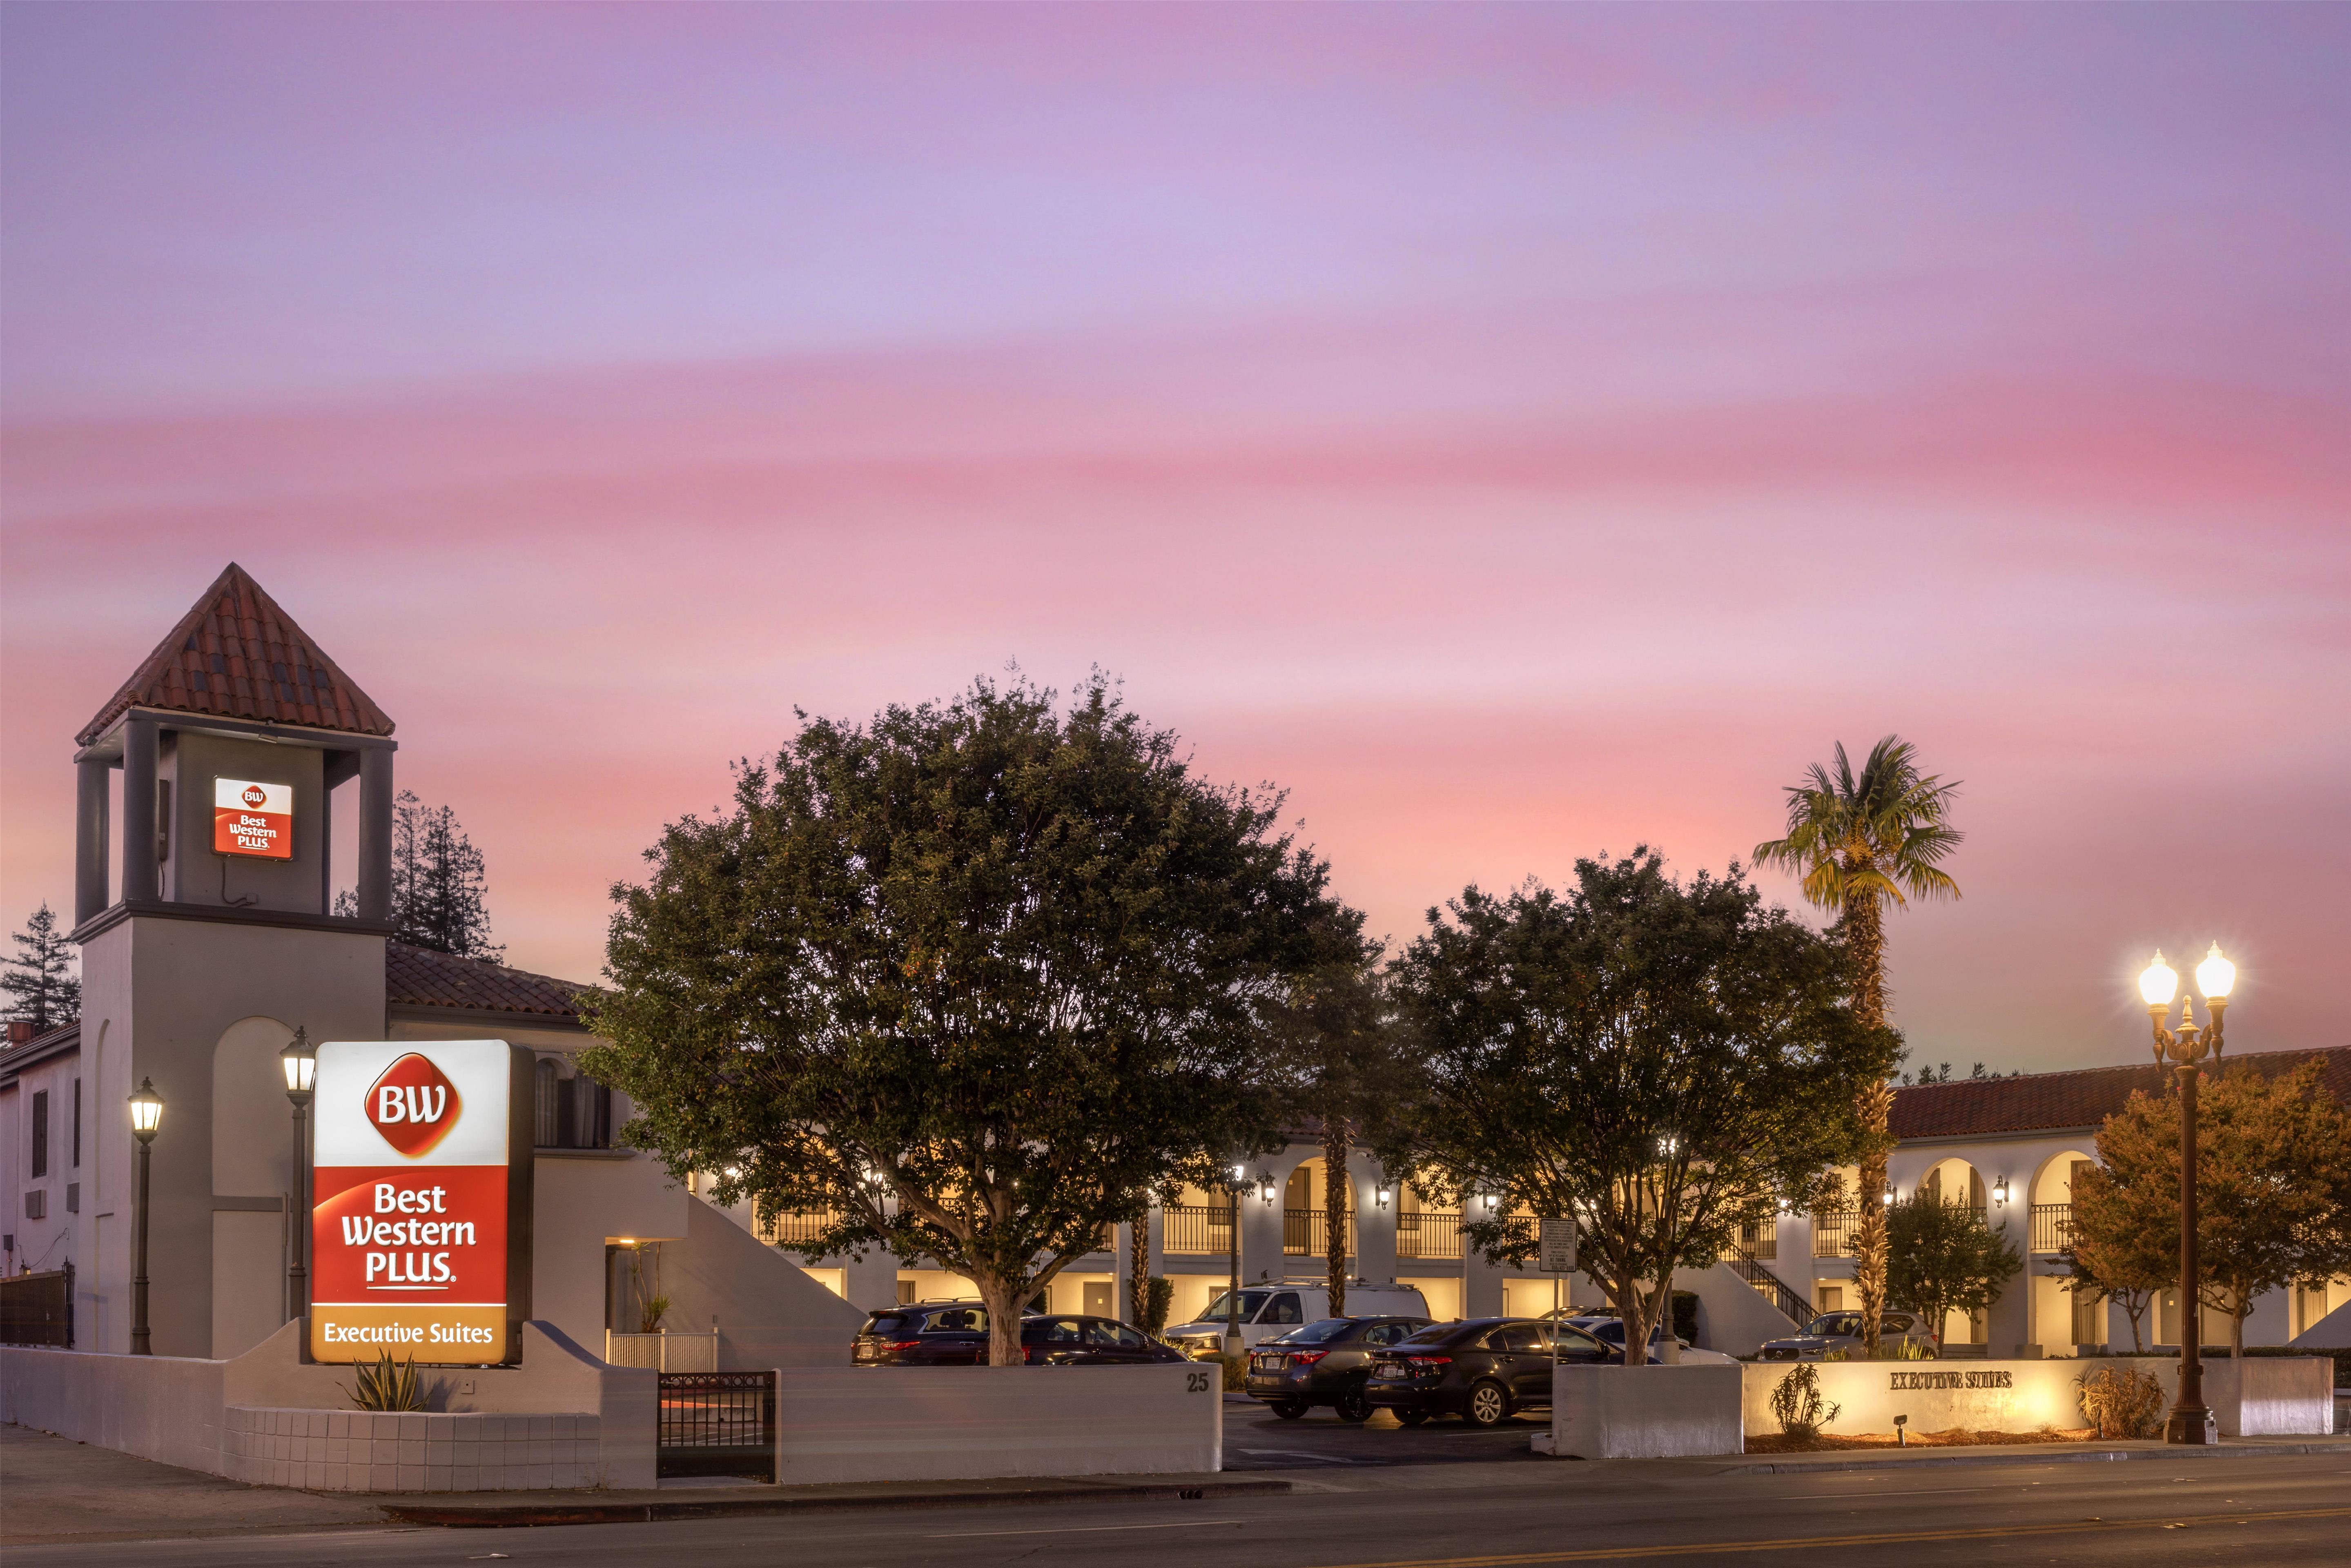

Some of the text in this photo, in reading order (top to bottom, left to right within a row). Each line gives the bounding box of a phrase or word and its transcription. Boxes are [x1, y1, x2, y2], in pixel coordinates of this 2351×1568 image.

[245, 791, 263, 802] BW
[229, 823, 277, 838] Western
[240, 815, 266, 827] Best
[379, 1085, 446, 1124] BW
[375, 1183, 446, 1214] Best
[342, 1216, 477, 1246] Western
[325, 1322, 492, 1343] Executive Suites
[1187, 1372, 1209, 1392] 25
[1890, 1371, 1963, 1390] EXECUTIVE
